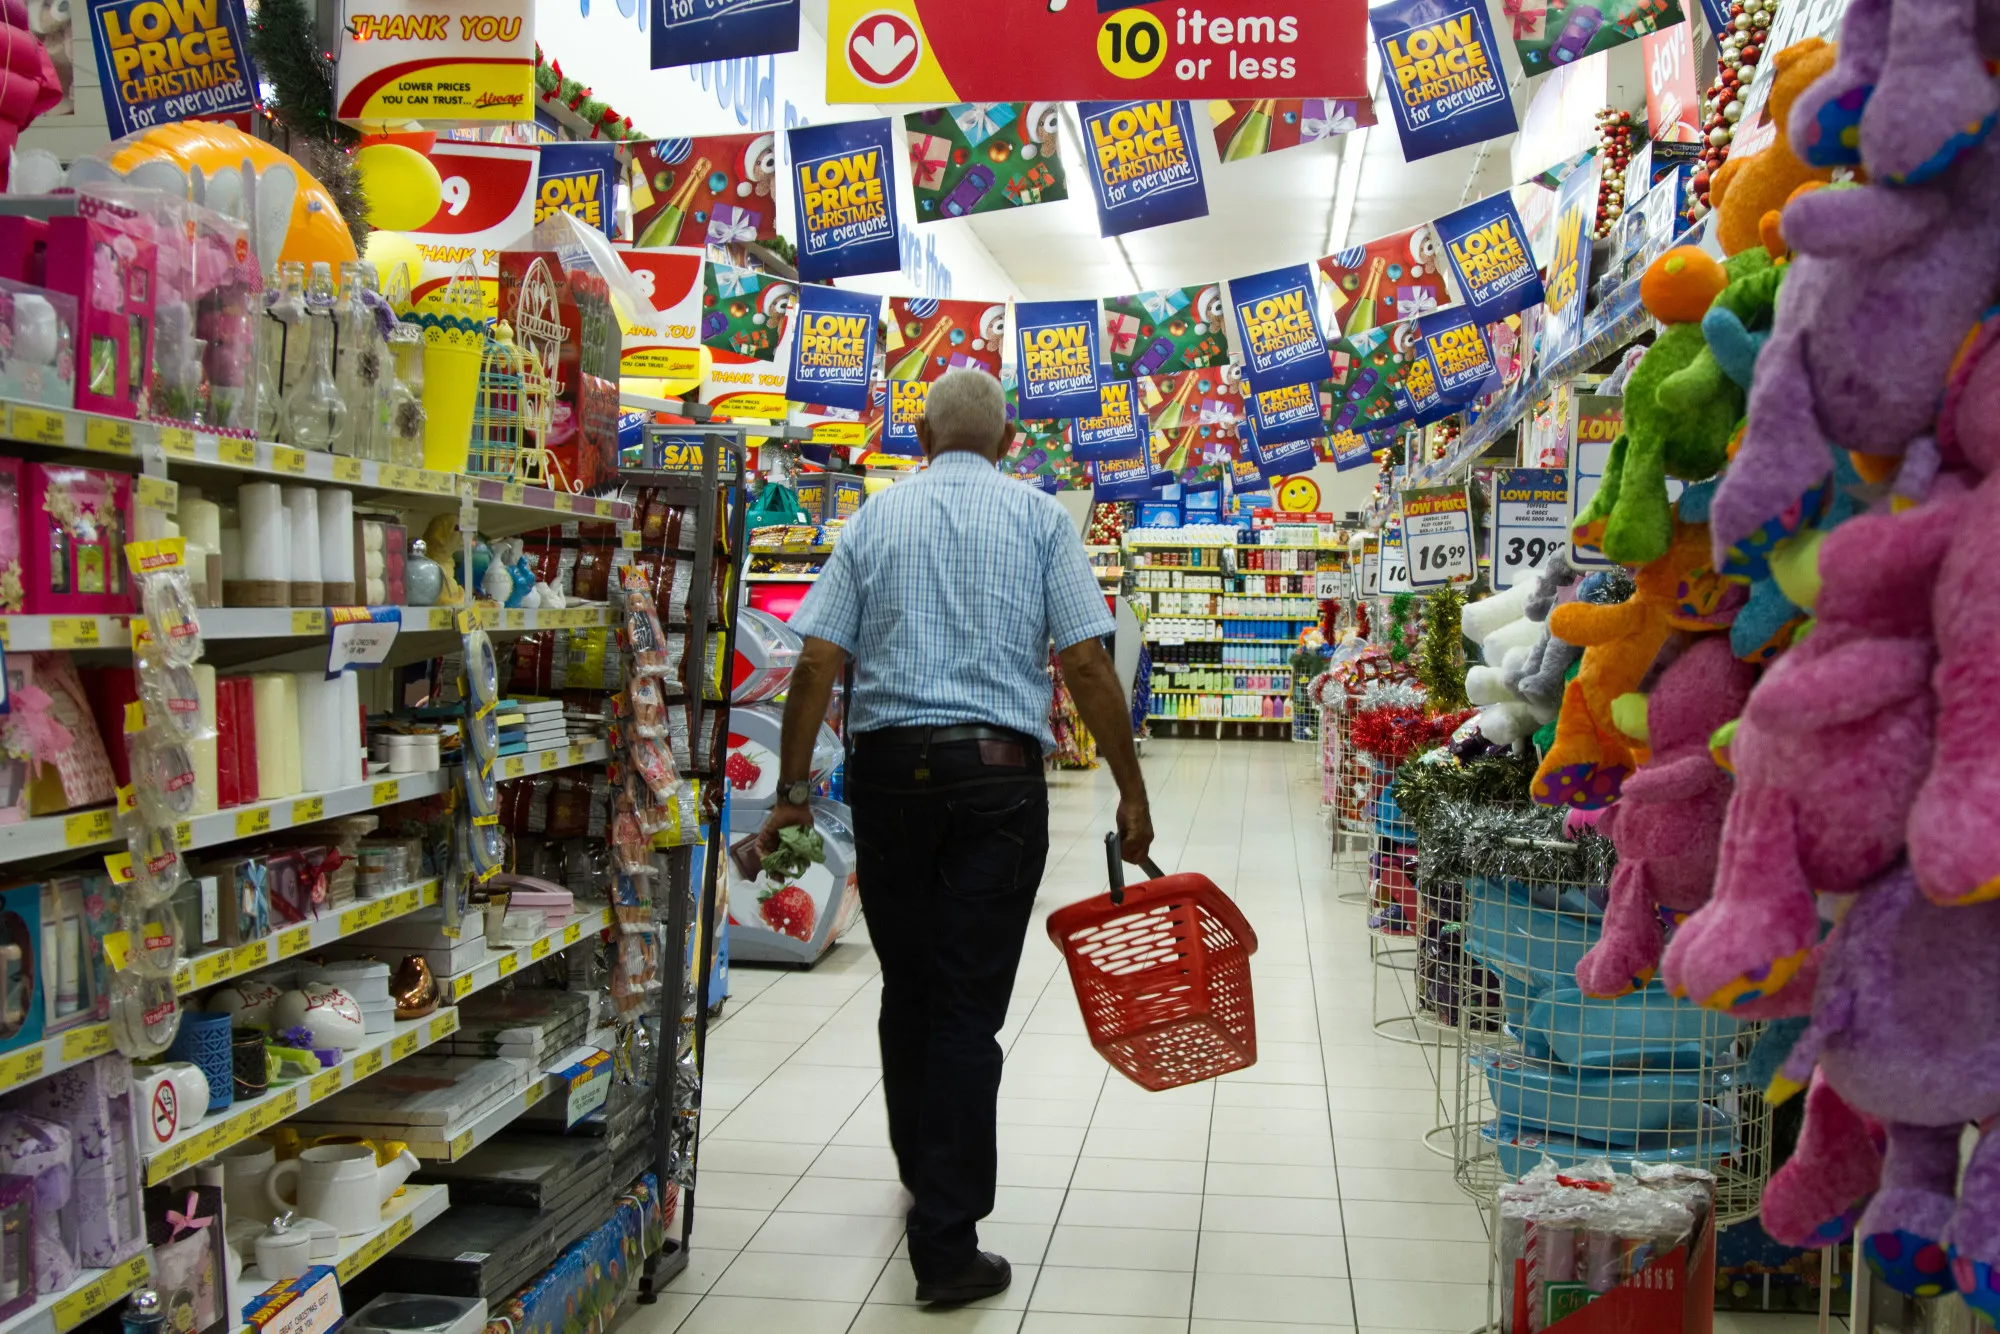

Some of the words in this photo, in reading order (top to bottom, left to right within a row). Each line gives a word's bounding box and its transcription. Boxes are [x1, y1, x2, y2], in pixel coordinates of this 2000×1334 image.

[103, 0, 218, 48] LOW
[351, 14, 449, 41] THANK
[460, 15, 522, 42] YOU
[1105, 21, 1160, 64] 10
[1176, 8, 1299, 45] items
[113, 27, 236, 81] PRICE
[1386, 13, 1471, 68] LOW
[1175, 58, 1211, 81] or
[1230, 50, 1296, 80] less
[1395, 40, 1486, 91] PRICE
[121, 58, 241, 104] CHRISTMAS
[399, 82, 433, 92] LOWER
[437, 82, 471, 92] PRICES
[1404, 64, 1491, 106] CHRISTMAS
[129, 104, 157, 129] for
[165, 79, 246, 118] everyone
[382, 95, 403, 104] YOU
[407, 96, 428, 105] CAN
[473, 91, 524, 108] Always
[1411, 105, 1431, 125] for
[1436, 78, 1496, 113] everyone
[1090, 100, 1171, 148] LOW
[1097, 124, 1184, 171] PRICE
[801, 151, 878, 193] LOW
[1103, 147, 1187, 186] CHRISTMAS
[804, 178, 884, 216] PRICE
[1108, 184, 1127, 203] for
[1132, 161, 1191, 192] everyone
[807, 201, 885, 232] CHRISTMAS
[810, 232, 828, 249] for
[833, 215, 888, 241] everyone
[1451, 218, 1511, 263] LOW
[1459, 237, 1523, 279] PRICE
[1468, 253, 1527, 290] CHRISTMAS
[1474, 288, 1490, 302] for
[1492, 263, 1531, 291] everyone
[1242, 290, 1303, 327] LOW
[803, 314, 866, 338] LOW
[1023, 325, 1086, 351] LOW
[1248, 310, 1312, 344] PRICE
[1428, 323, 1478, 354] LOW
[801, 334, 865, 356] PRICE
[1253, 327, 1315, 356] CHRISTMAS
[1257, 354, 1272, 369] for
[1275, 336, 1319, 361] everyone
[1435, 338, 1485, 368] PRICE
[800, 352, 863, 369] CHRISTMAS
[1025, 346, 1090, 369] PRICE
[1027, 363, 1091, 382] CHRISTMAS
[1439, 353, 1489, 378] CHRISTMAS
[711, 371, 754, 384] THANK
[759, 374, 785, 386] YOU
[800, 366, 816, 378] for
[819, 366, 864, 380] everyone
[1030, 381, 1045, 397] for
[1049, 374, 1093, 392] everyone
[1443, 375, 1456, 387] for
[1458, 360, 1491, 382] everyone
[1258, 382, 1311, 405] PRICE
[1261, 395, 1312, 415] CHRISTMAS
[1079, 415, 1132, 430] CHRISTMAS
[1101, 401, 1131, 417] ICE
[1263, 413, 1277, 427] for
[1279, 402, 1315, 423] everyone
[1081, 430, 1094, 442] for
[1096, 423, 1134, 439] everyone
[1099, 459, 1145, 472] CHRISTMAS
[838, 488, 859, 504] SAVE
[1403, 502, 1431, 515] LOW
[1434, 498, 1467, 512] PRICE
[1500, 489, 1532, 501] LOW
[295, 1302, 317, 1325] CHRISTMAS
[318, 1292, 329, 1307] GIFT
[304, 1317, 313, 1328] YOU
